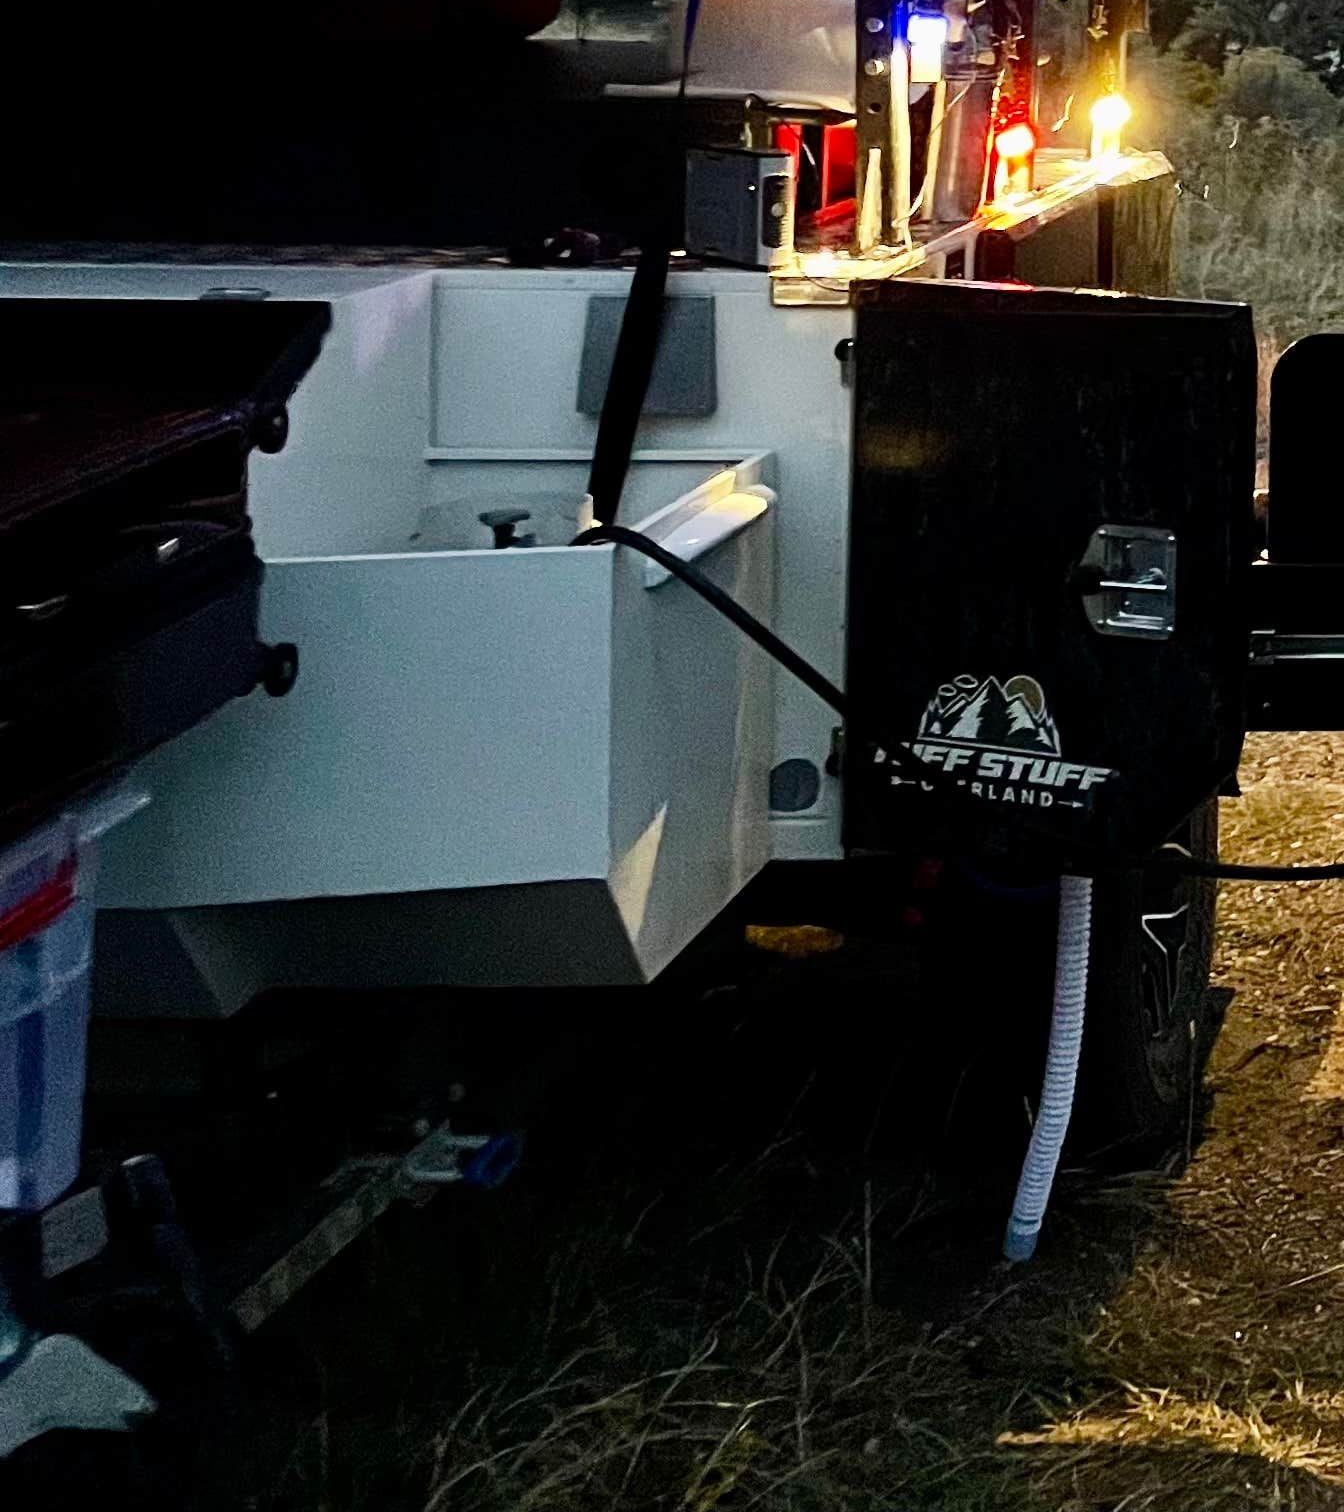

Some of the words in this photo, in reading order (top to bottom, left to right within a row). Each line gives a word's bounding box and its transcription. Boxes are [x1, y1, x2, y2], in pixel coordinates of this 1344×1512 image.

[873, 742, 976, 772] FF
[976, 752, 1114, 790] STUFF
[920, 779, 1054, 808] RLAND
